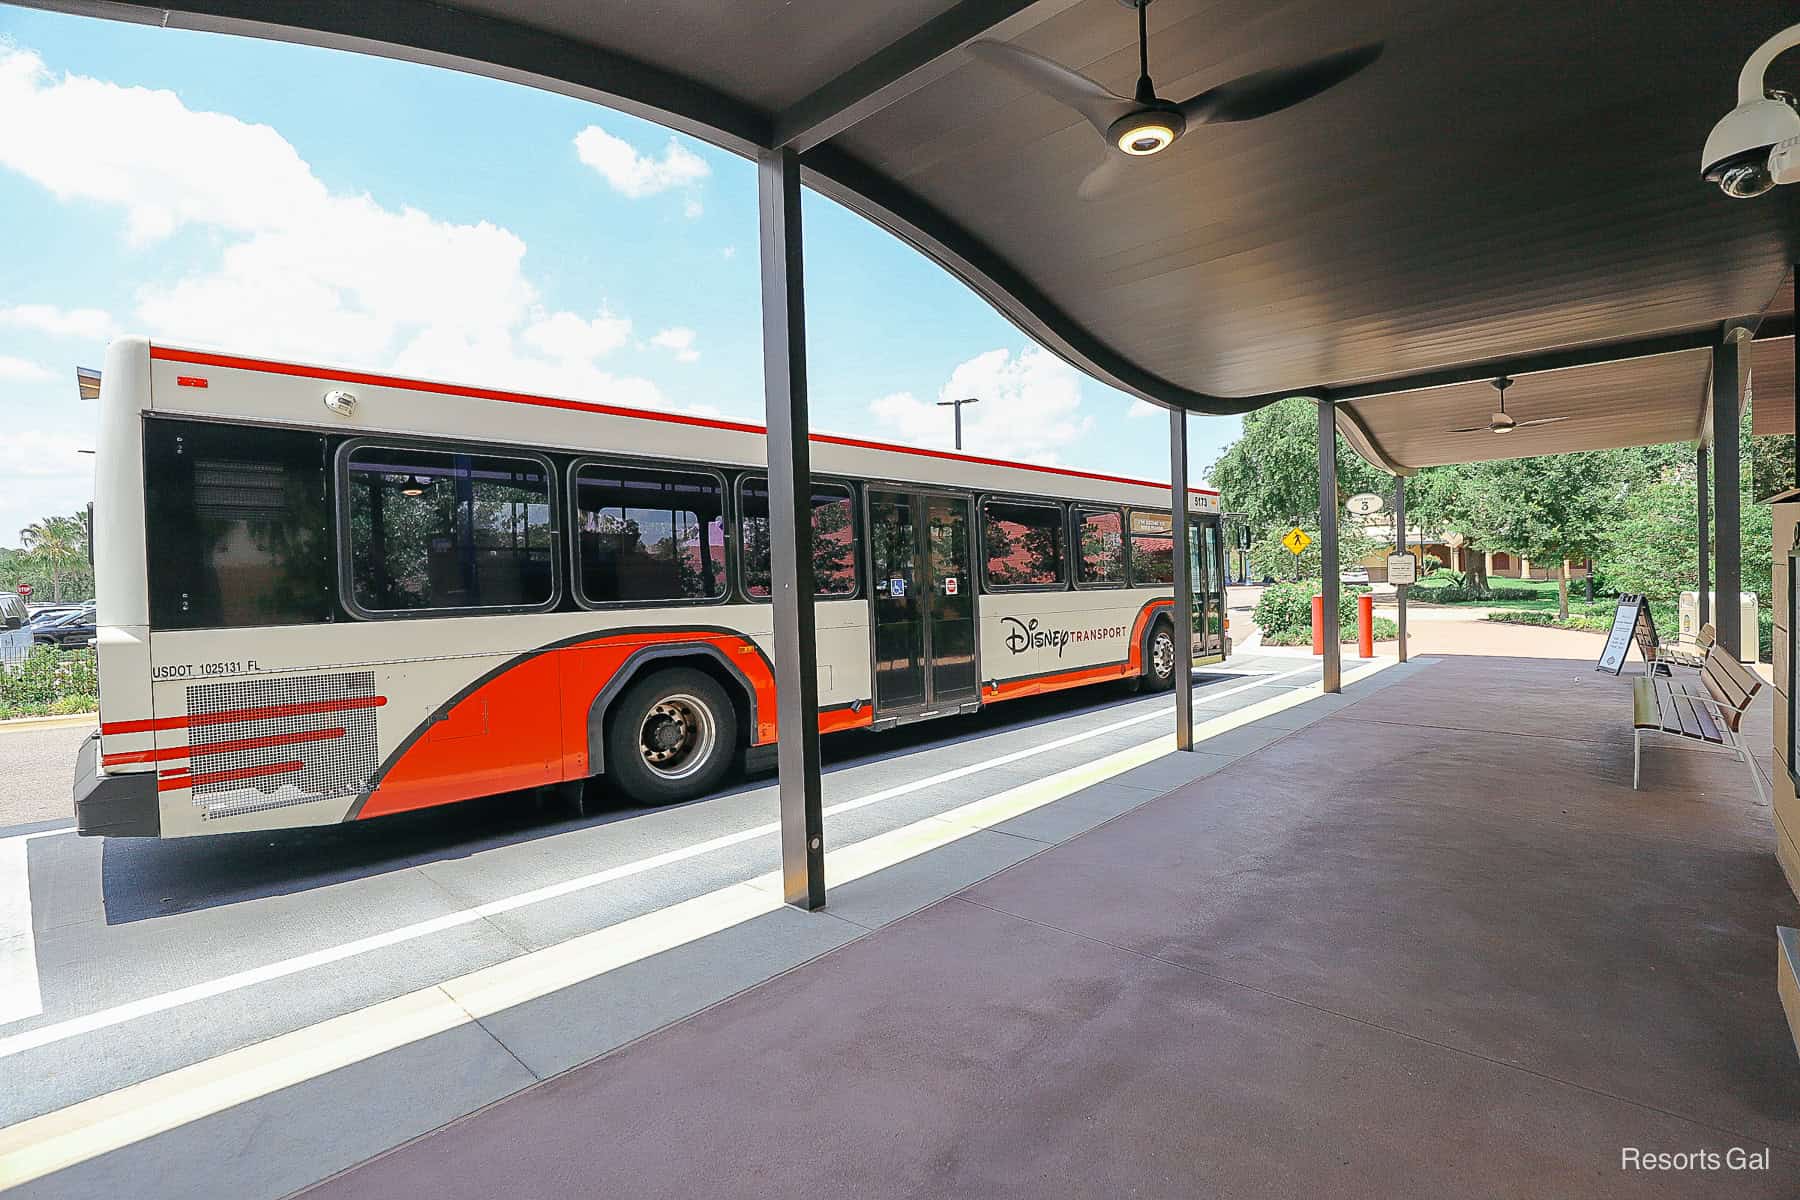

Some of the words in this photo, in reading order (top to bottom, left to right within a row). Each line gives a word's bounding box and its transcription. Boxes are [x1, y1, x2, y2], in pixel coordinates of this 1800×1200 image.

[1194, 496, 1208, 508] 5173
[1361, 501, 1369, 511] 3
[1070, 626, 1127, 643] TRANSPORT
[152, 664, 193, 678] USDOT
[200, 661, 241, 675] 1025131
[247, 660, 260, 672] FL
